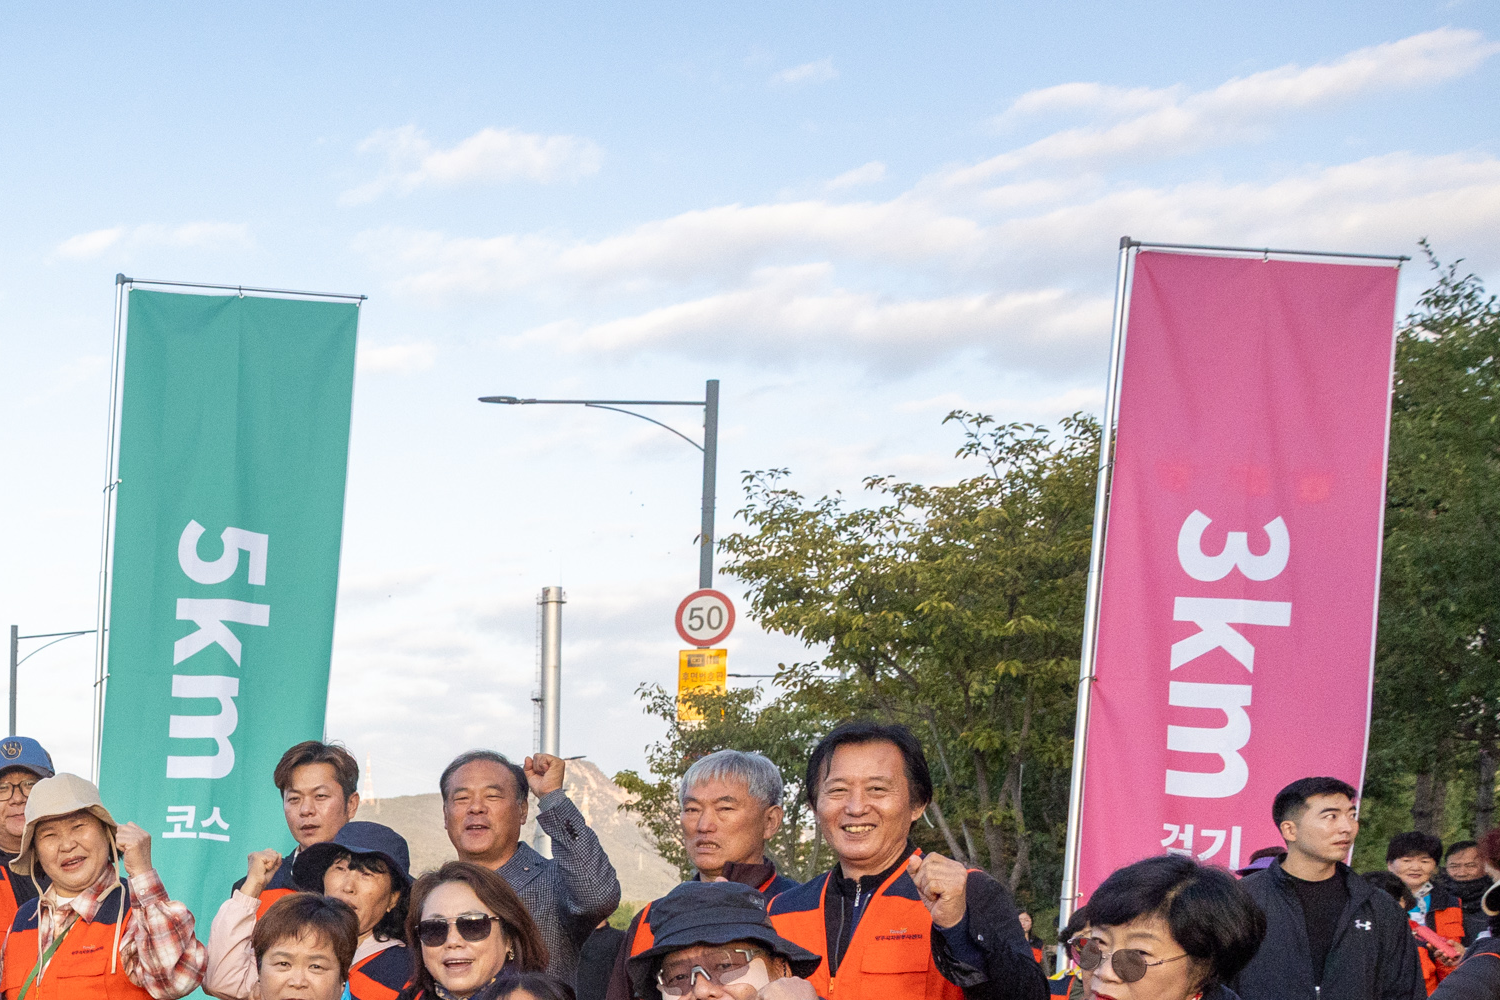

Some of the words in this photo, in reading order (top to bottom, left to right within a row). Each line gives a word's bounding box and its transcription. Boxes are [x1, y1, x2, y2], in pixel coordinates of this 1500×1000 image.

[687, 605, 724, 632] 50
[165, 518, 271, 779] 5km
[1164, 509, 1293, 799] 3km
[682, 671, 724, 683] 후면번호판
[162, 805, 230, 842] 코스
[1160, 823, 1242, 870] 걷기
